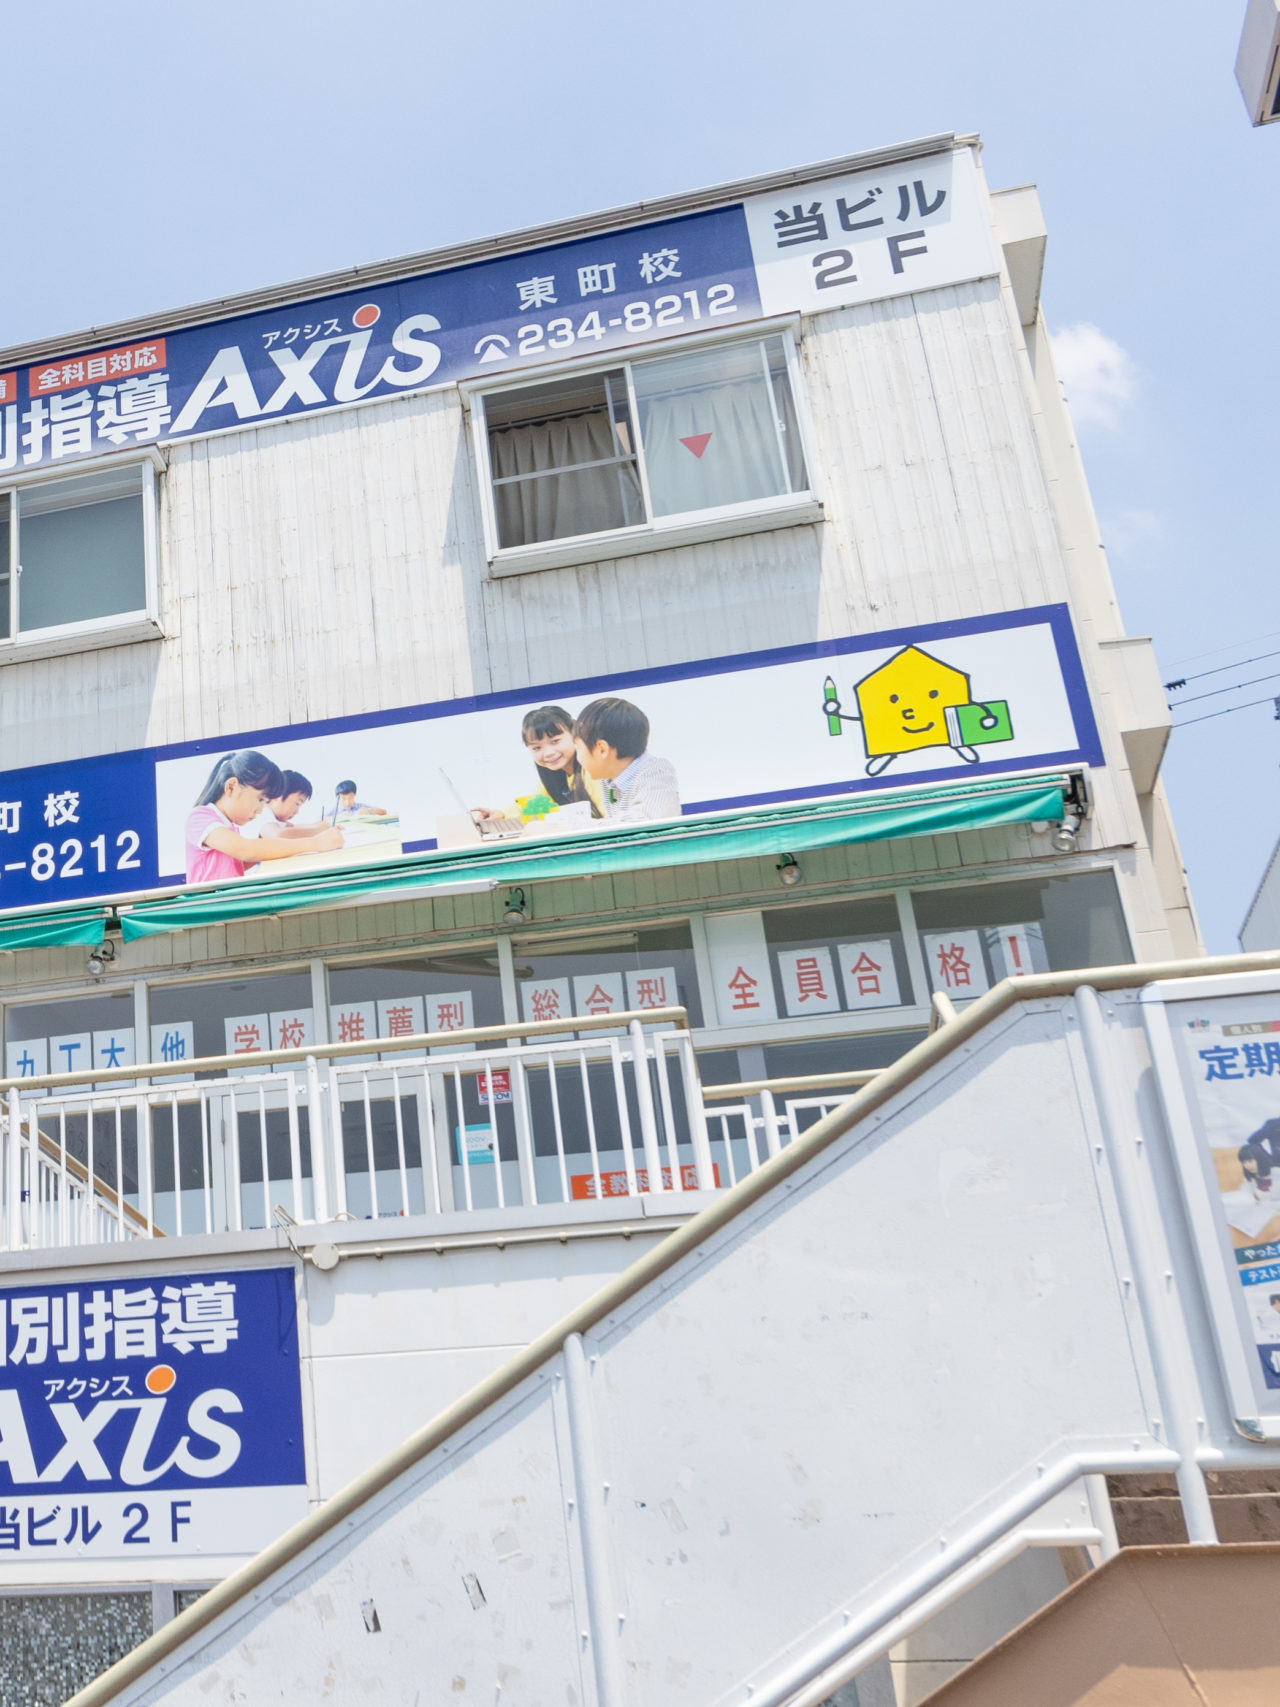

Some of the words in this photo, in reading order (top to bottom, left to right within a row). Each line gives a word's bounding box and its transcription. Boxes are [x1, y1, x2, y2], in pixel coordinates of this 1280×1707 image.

[773, 178, 947, 249] 当ビル
[516, 248, 683, 312] 東町校
[261, 318, 343, 350] アクシス
[517, 283, 738, 357] 234-8212
[37, 346, 159, 391] 全科目対応
[168, 303, 442, 433] Axis
[44, 1375, 133, 1401] アクシス
